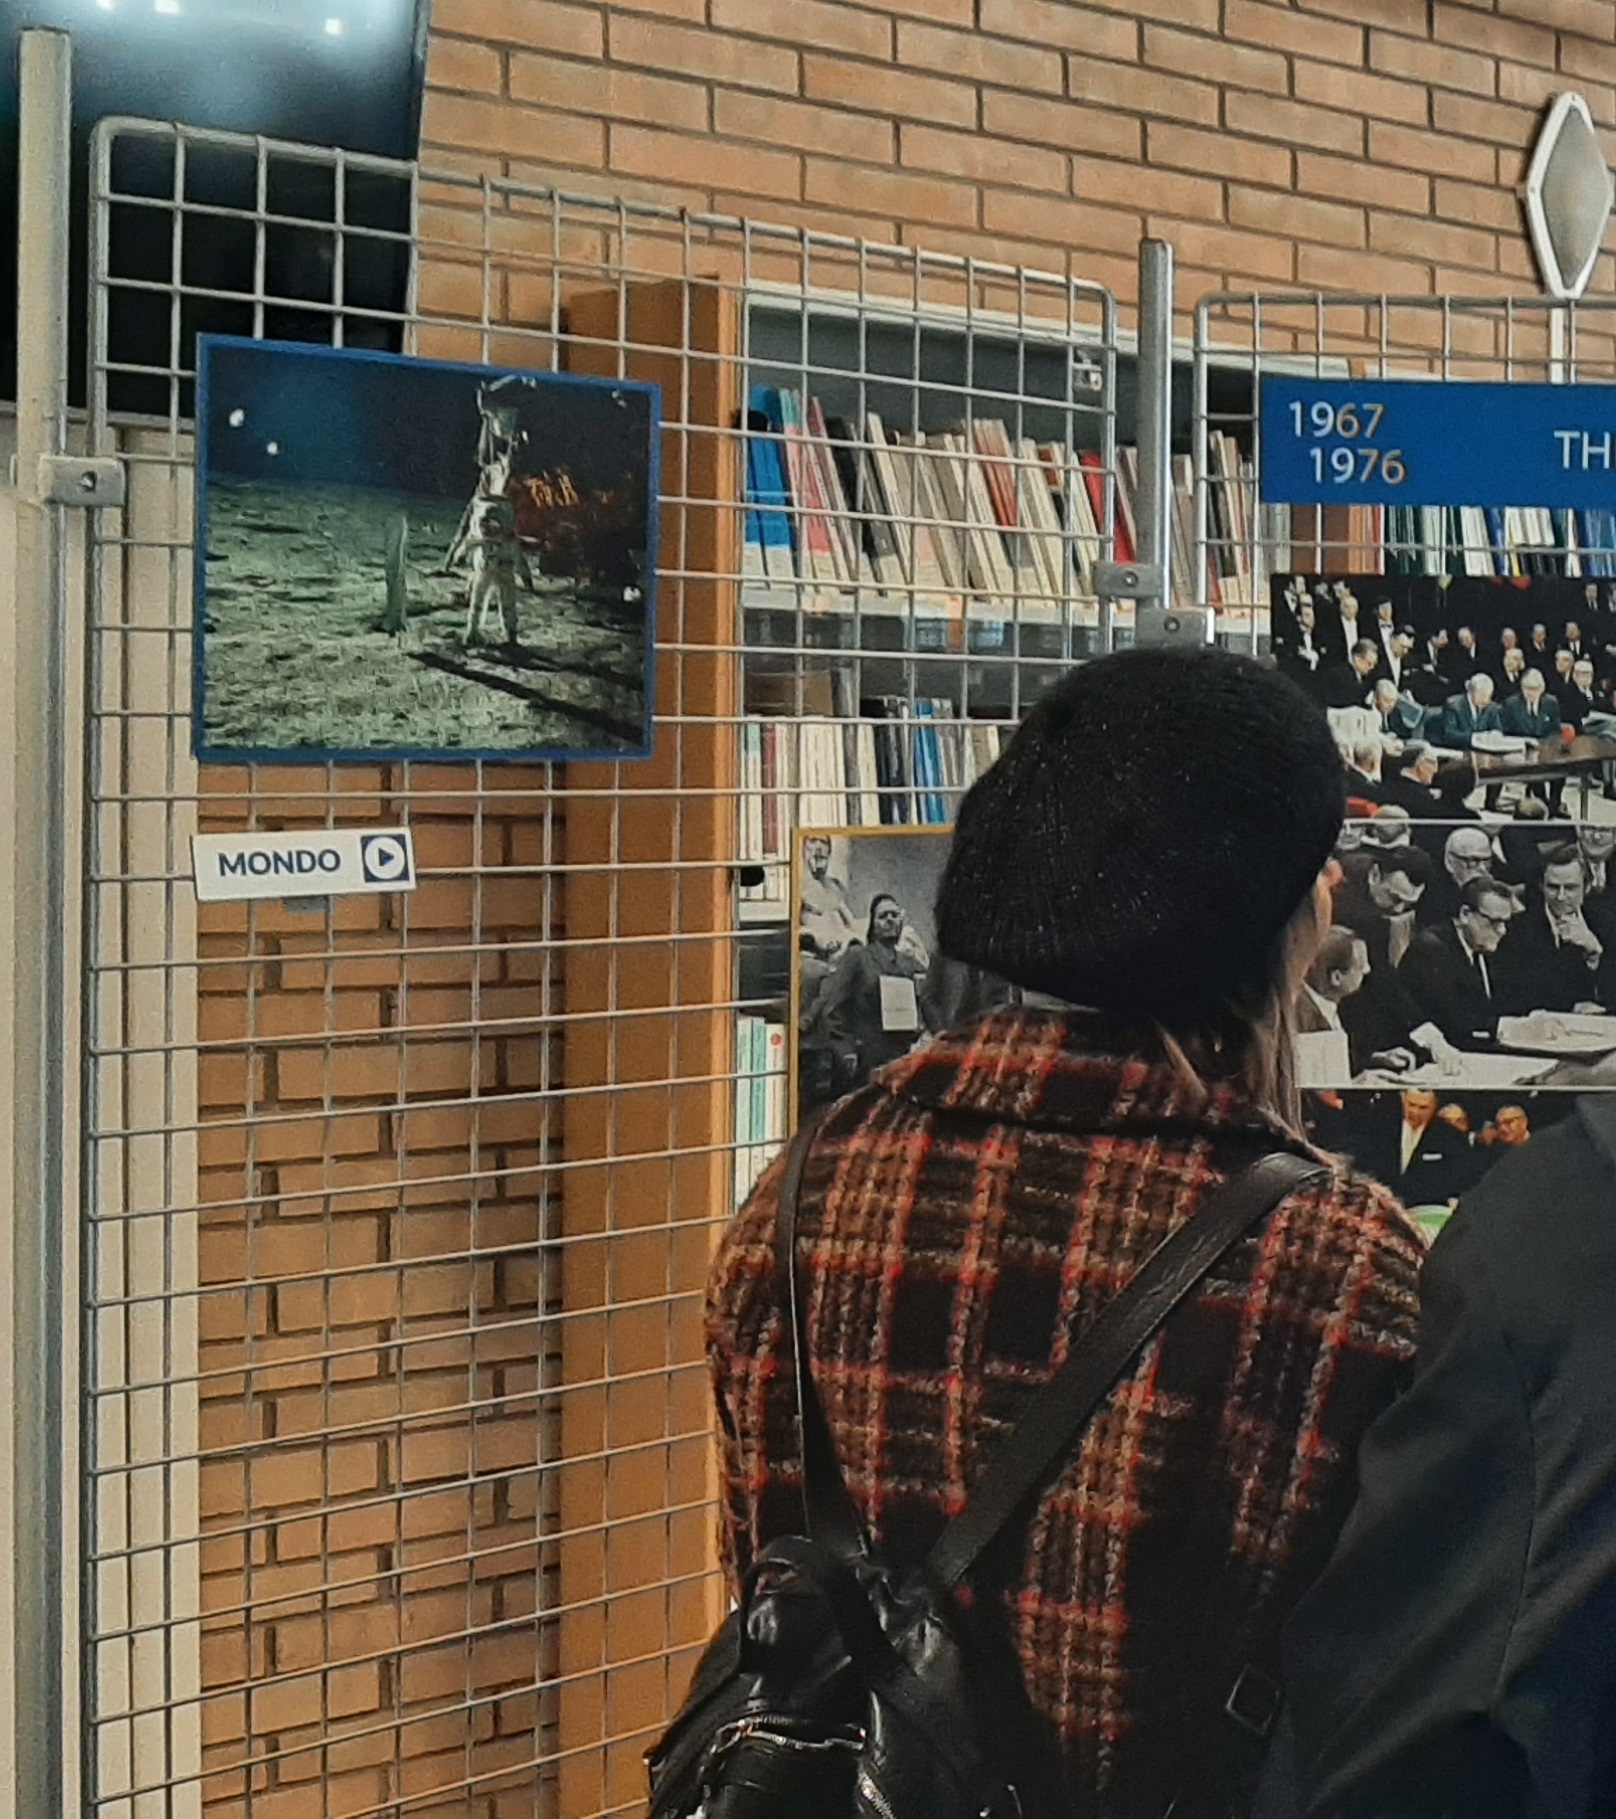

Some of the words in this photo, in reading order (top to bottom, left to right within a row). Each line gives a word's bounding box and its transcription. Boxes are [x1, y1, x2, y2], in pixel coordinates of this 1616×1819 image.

[1288, 401, 1385, 439] 1967
[1309, 447, 1407, 486] 1976
[218, 848, 341, 877] MONDO
